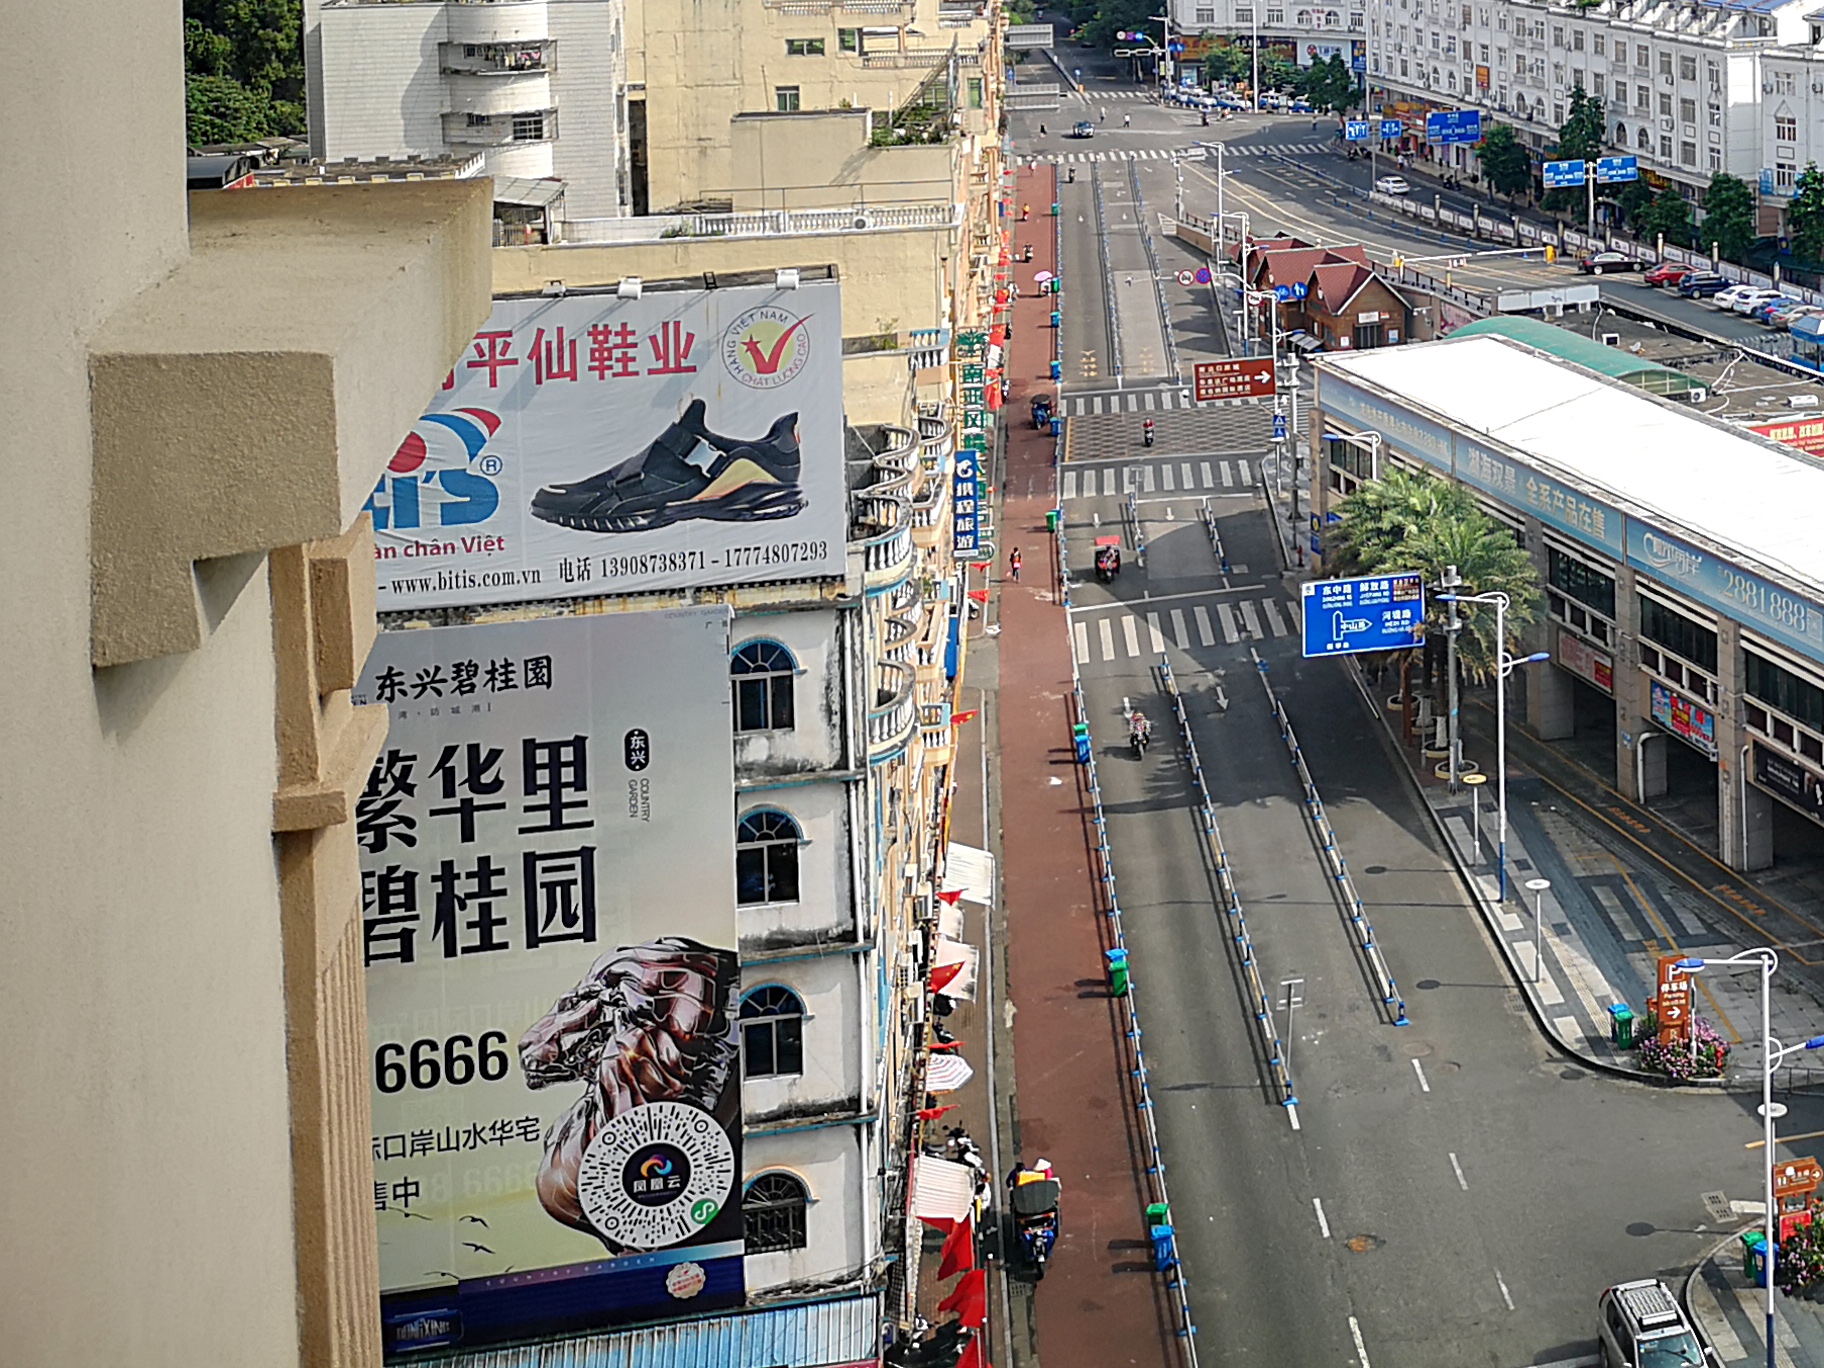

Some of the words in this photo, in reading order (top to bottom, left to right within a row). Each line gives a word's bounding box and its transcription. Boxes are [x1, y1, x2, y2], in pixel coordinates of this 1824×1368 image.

[760, 311, 789, 323] NAM
[1526, 476, 1606, 541] 全系产品在售
[403, 538, 456, 559] chân
[460, 534, 505, 557] Việt
[559, 558, 592, 584] 电话
[600, 550, 706, 579] 13908738371
[725, 541, 829, 569] 17774807293
[391, 569, 542, 595] www.bitis.com.vn
[630, 736, 646, 765] 东兴
[628, 779, 639, 818] GARDEN
[640, 778, 650, 822] COUNTRY
[361, 845, 599, 969] 碧桂园
[375, 1031, 509, 1094] 6666
